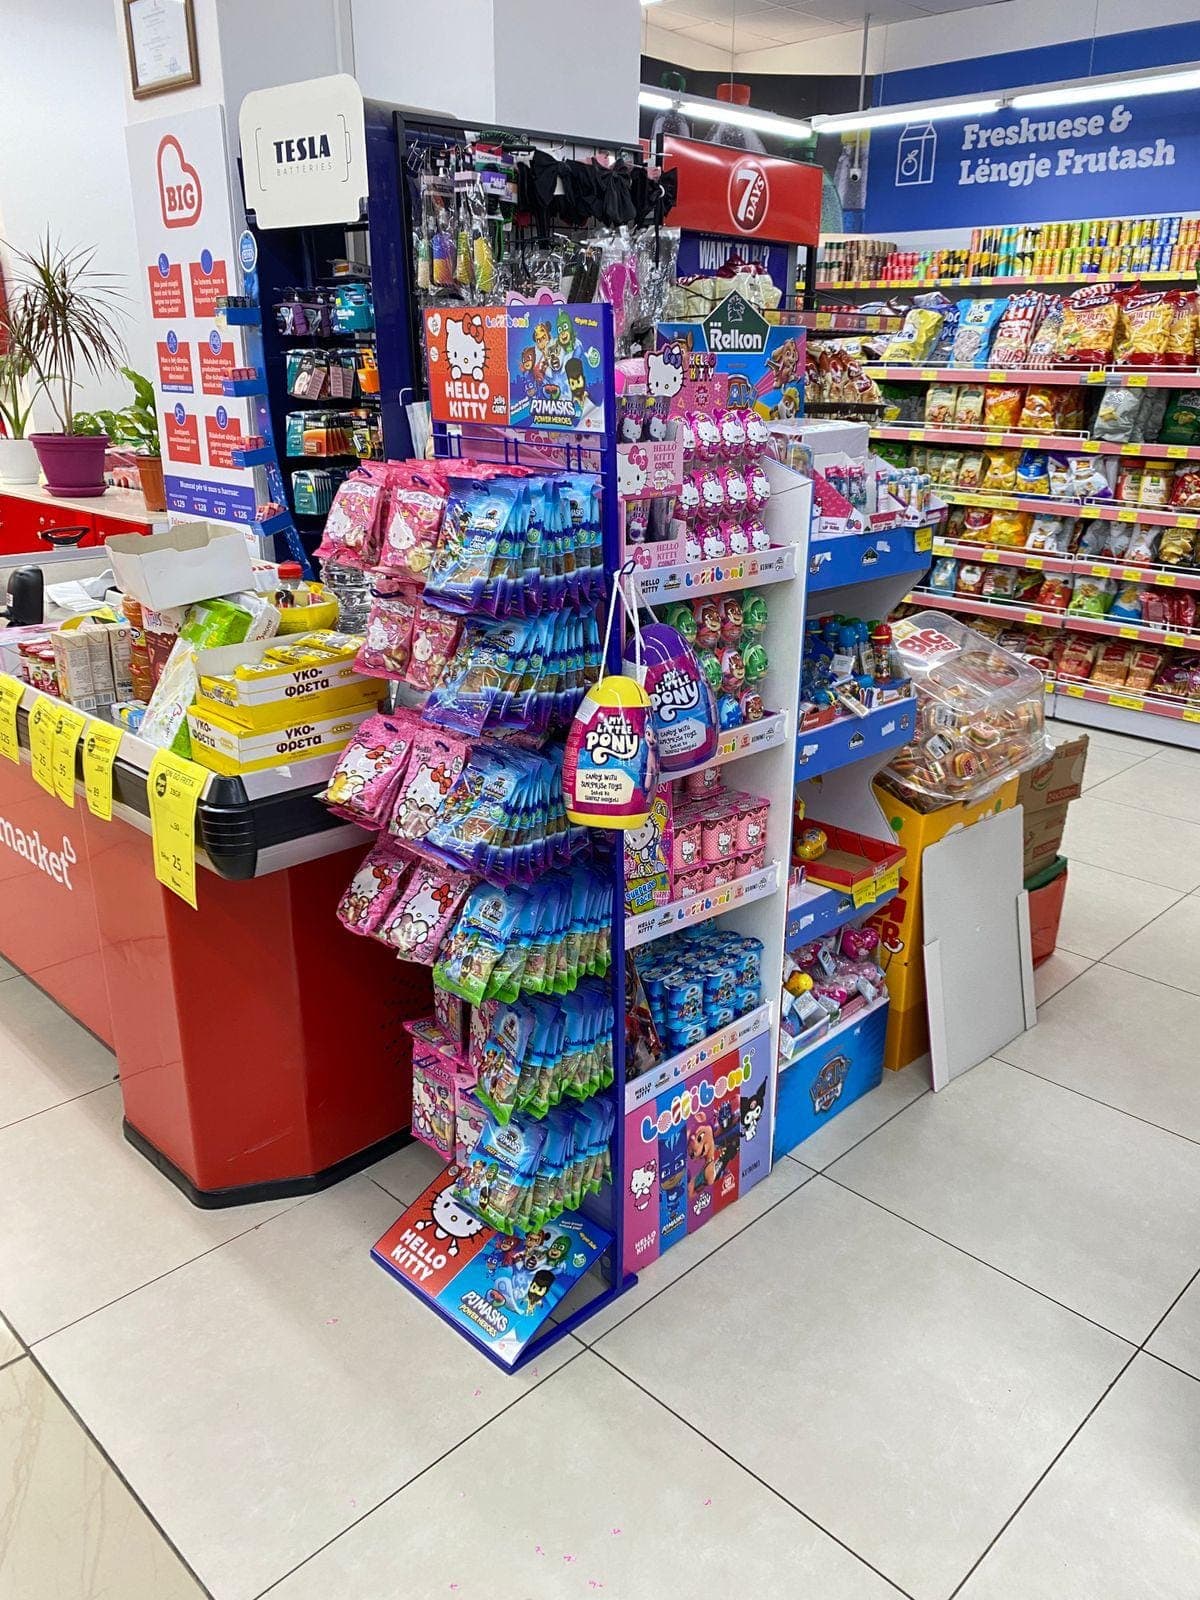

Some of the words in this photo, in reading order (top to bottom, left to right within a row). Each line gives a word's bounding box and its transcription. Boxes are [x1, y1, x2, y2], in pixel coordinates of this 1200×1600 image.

[962, 116, 1104, 151] Freskuese
[1109, 104, 1133, 133] &
[273, 134, 331, 164] TESLA
[276, 162, 333, 177] BATTERIES
[958, 156, 1051, 187] Lëngje
[1055, 138, 1176, 176] Frutash
[165, 182, 196, 213] BIG
[736, 168, 759, 222] 7
[745, 175, 765, 221] DAYS
[699, 240, 734, 270] WANT
[710, 329, 762, 351] Relkon
[445, 381, 490, 400] HELLO
[449, 401, 488, 420] KITTY
[653, 444, 677, 452] HELLO
[653, 454, 676, 462] KITTY
[656, 543, 679, 551] HELLO
[656, 552, 677, 560] KITTY
[641, 578, 660, 586] HELLO
[641, 586, 659, 594] KITTY
[901, 628, 957, 656] BIG
[655, 674, 691, 694] LITTLE
[663, 669, 677, 681] MY
[284, 679, 330, 697] φρετα
[649, 680, 699, 721] PONY
[596, 723, 633, 735] LITTLE
[608, 715, 624, 726] MY
[276, 735, 322, 753] φρετα
[585, 731, 639, 764] PONY
[608, 783, 623, 792] TOYS
[172, 854, 182, 872] 25
[637, 918, 656, 930] HELLO
[637, 925, 654, 935] KITTY
[634, 1082, 652, 1095] HELLO
[635, 1088, 651, 1100] KITTY
[635, 1230, 657, 1250] HELLO
[636, 1239, 656, 1255] KITTY
[400, 1229, 447, 1270] HELLO
[390, 1245, 434, 1281] KITTY
[458, 1302, 482, 1323] POWER
[477, 1317, 498, 1338] HEROES
